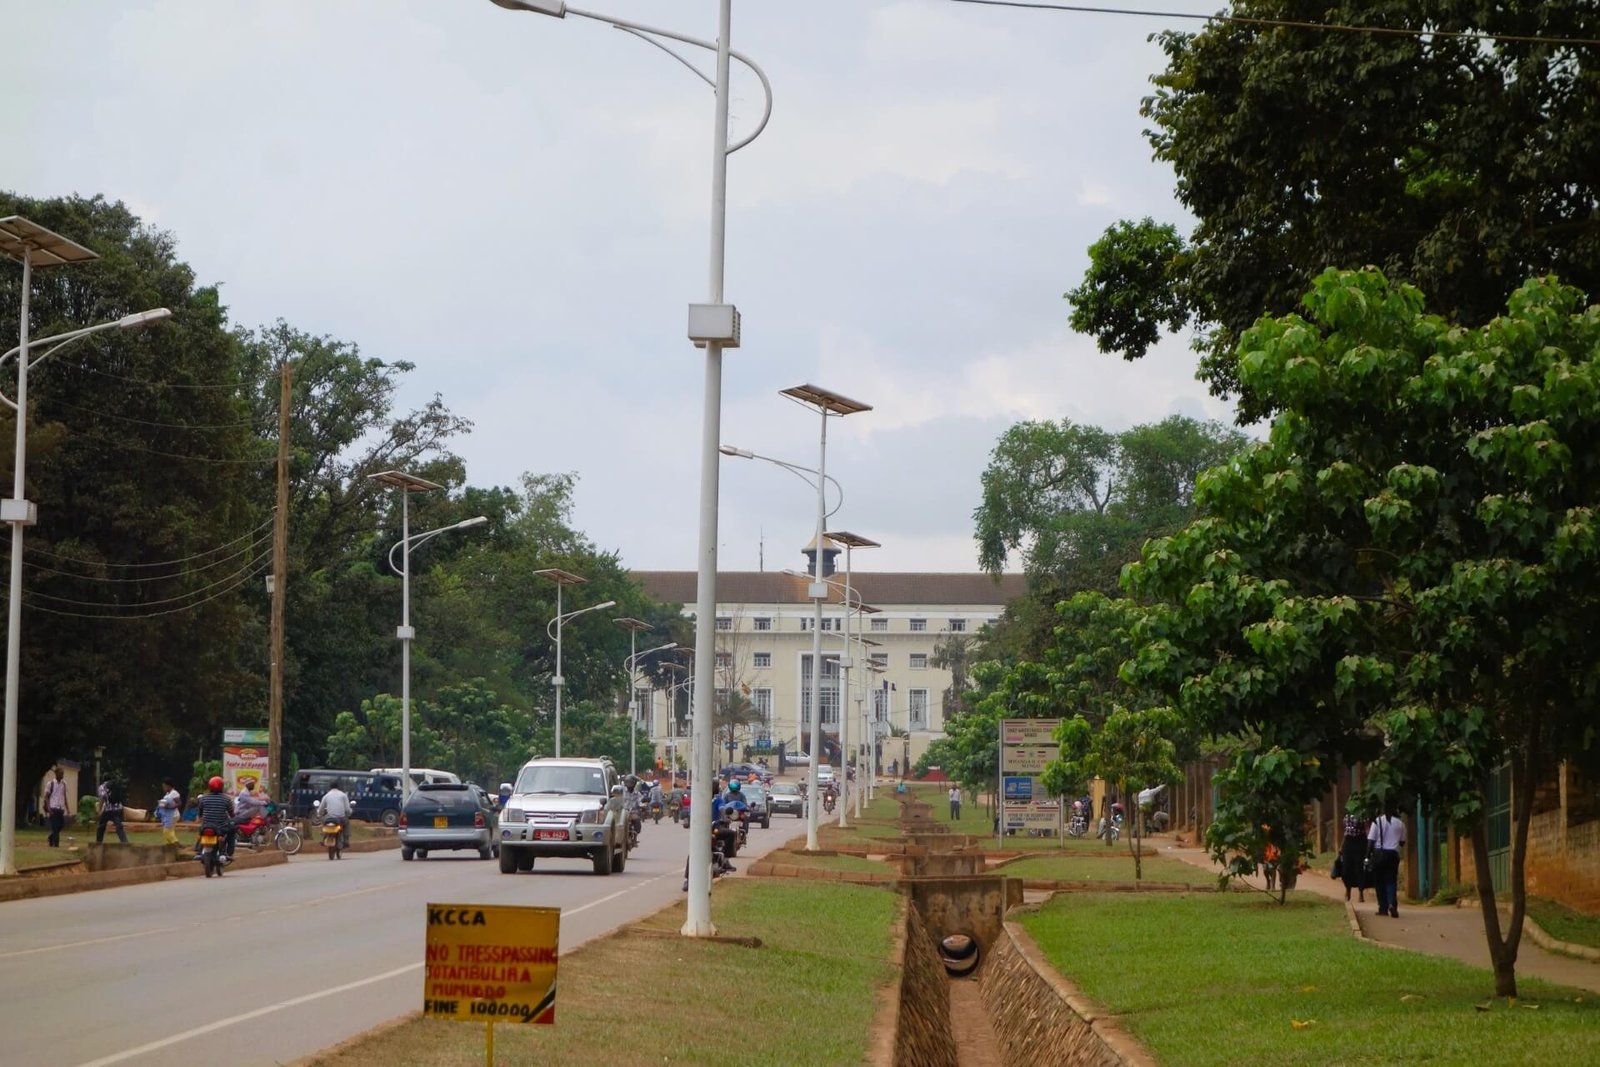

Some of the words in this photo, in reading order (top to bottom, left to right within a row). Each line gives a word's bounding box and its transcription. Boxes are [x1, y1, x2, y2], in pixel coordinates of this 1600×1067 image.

[429, 908, 486, 926] KCCA
[426, 943, 449, 961] NO
[424, 1000, 459, 1014] FINE
[470, 1002, 530, 1017] 100000
